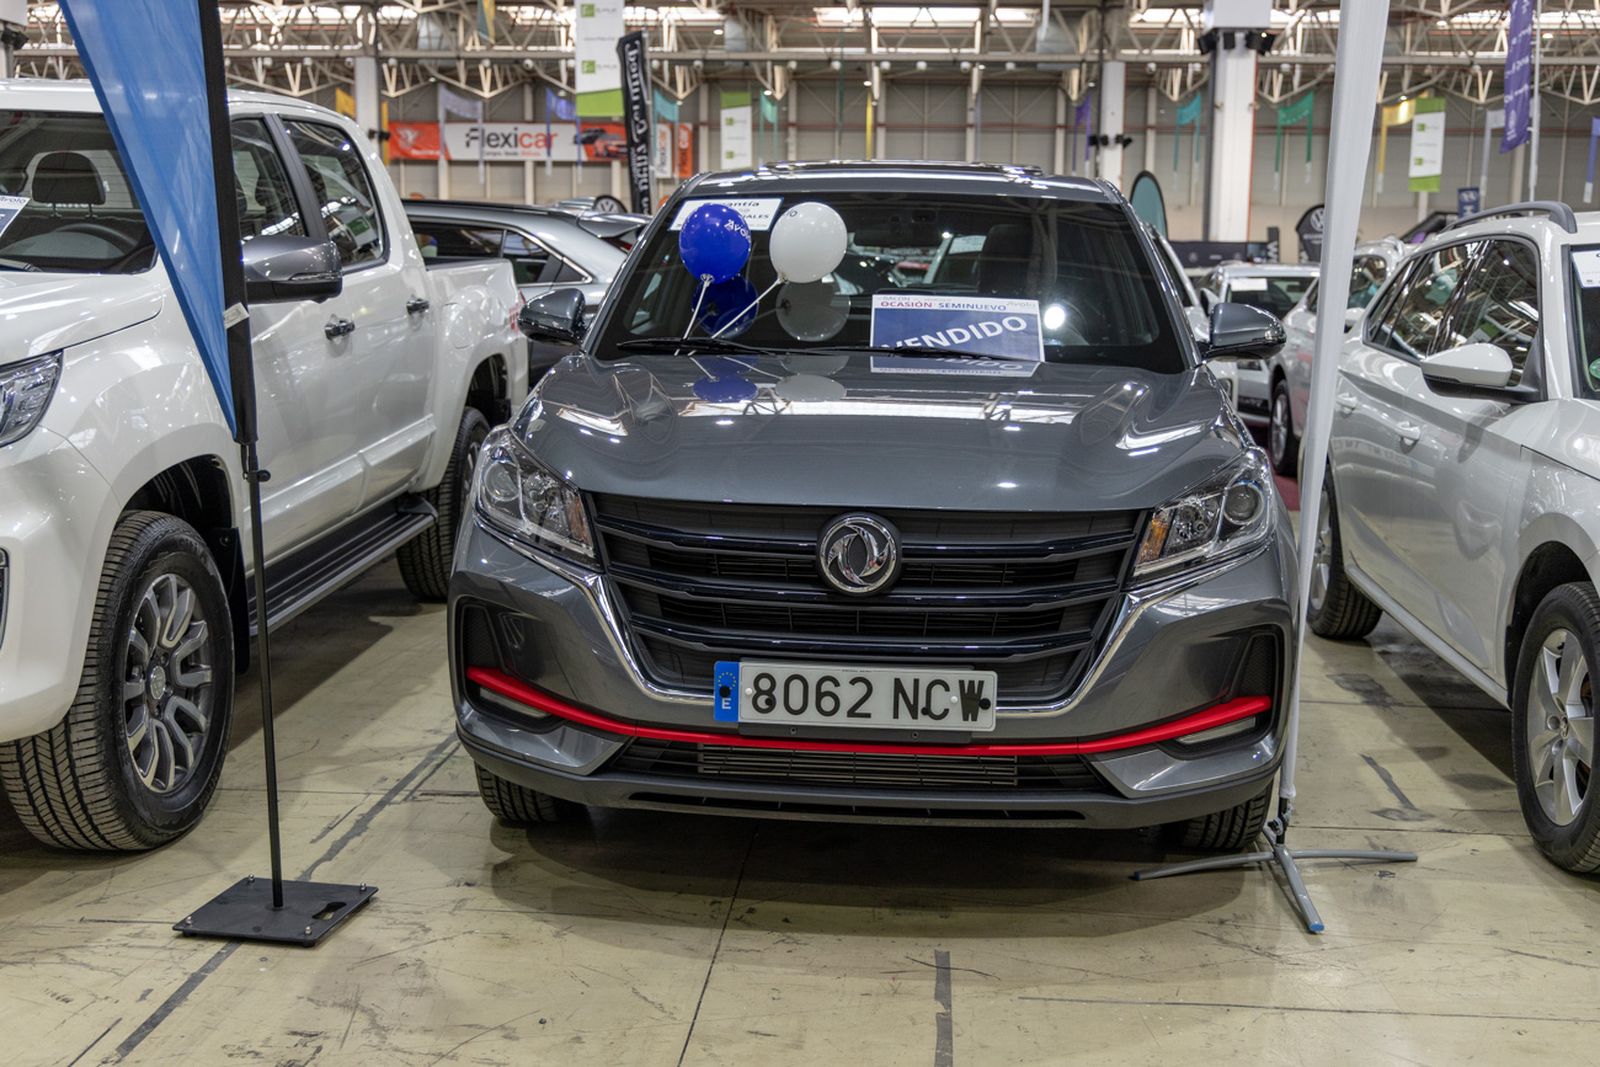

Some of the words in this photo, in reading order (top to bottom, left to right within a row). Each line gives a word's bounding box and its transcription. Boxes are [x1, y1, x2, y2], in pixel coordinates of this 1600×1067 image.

[465, 127, 557, 149] Flexicar
[880, 300, 932, 309] OCASIÓN
[938, 302, 1007, 311] SEMINUEVO
[721, 698, 731, 710] E
[751, 672, 873, 719] 8062
[892, 677, 985, 722] NCW
